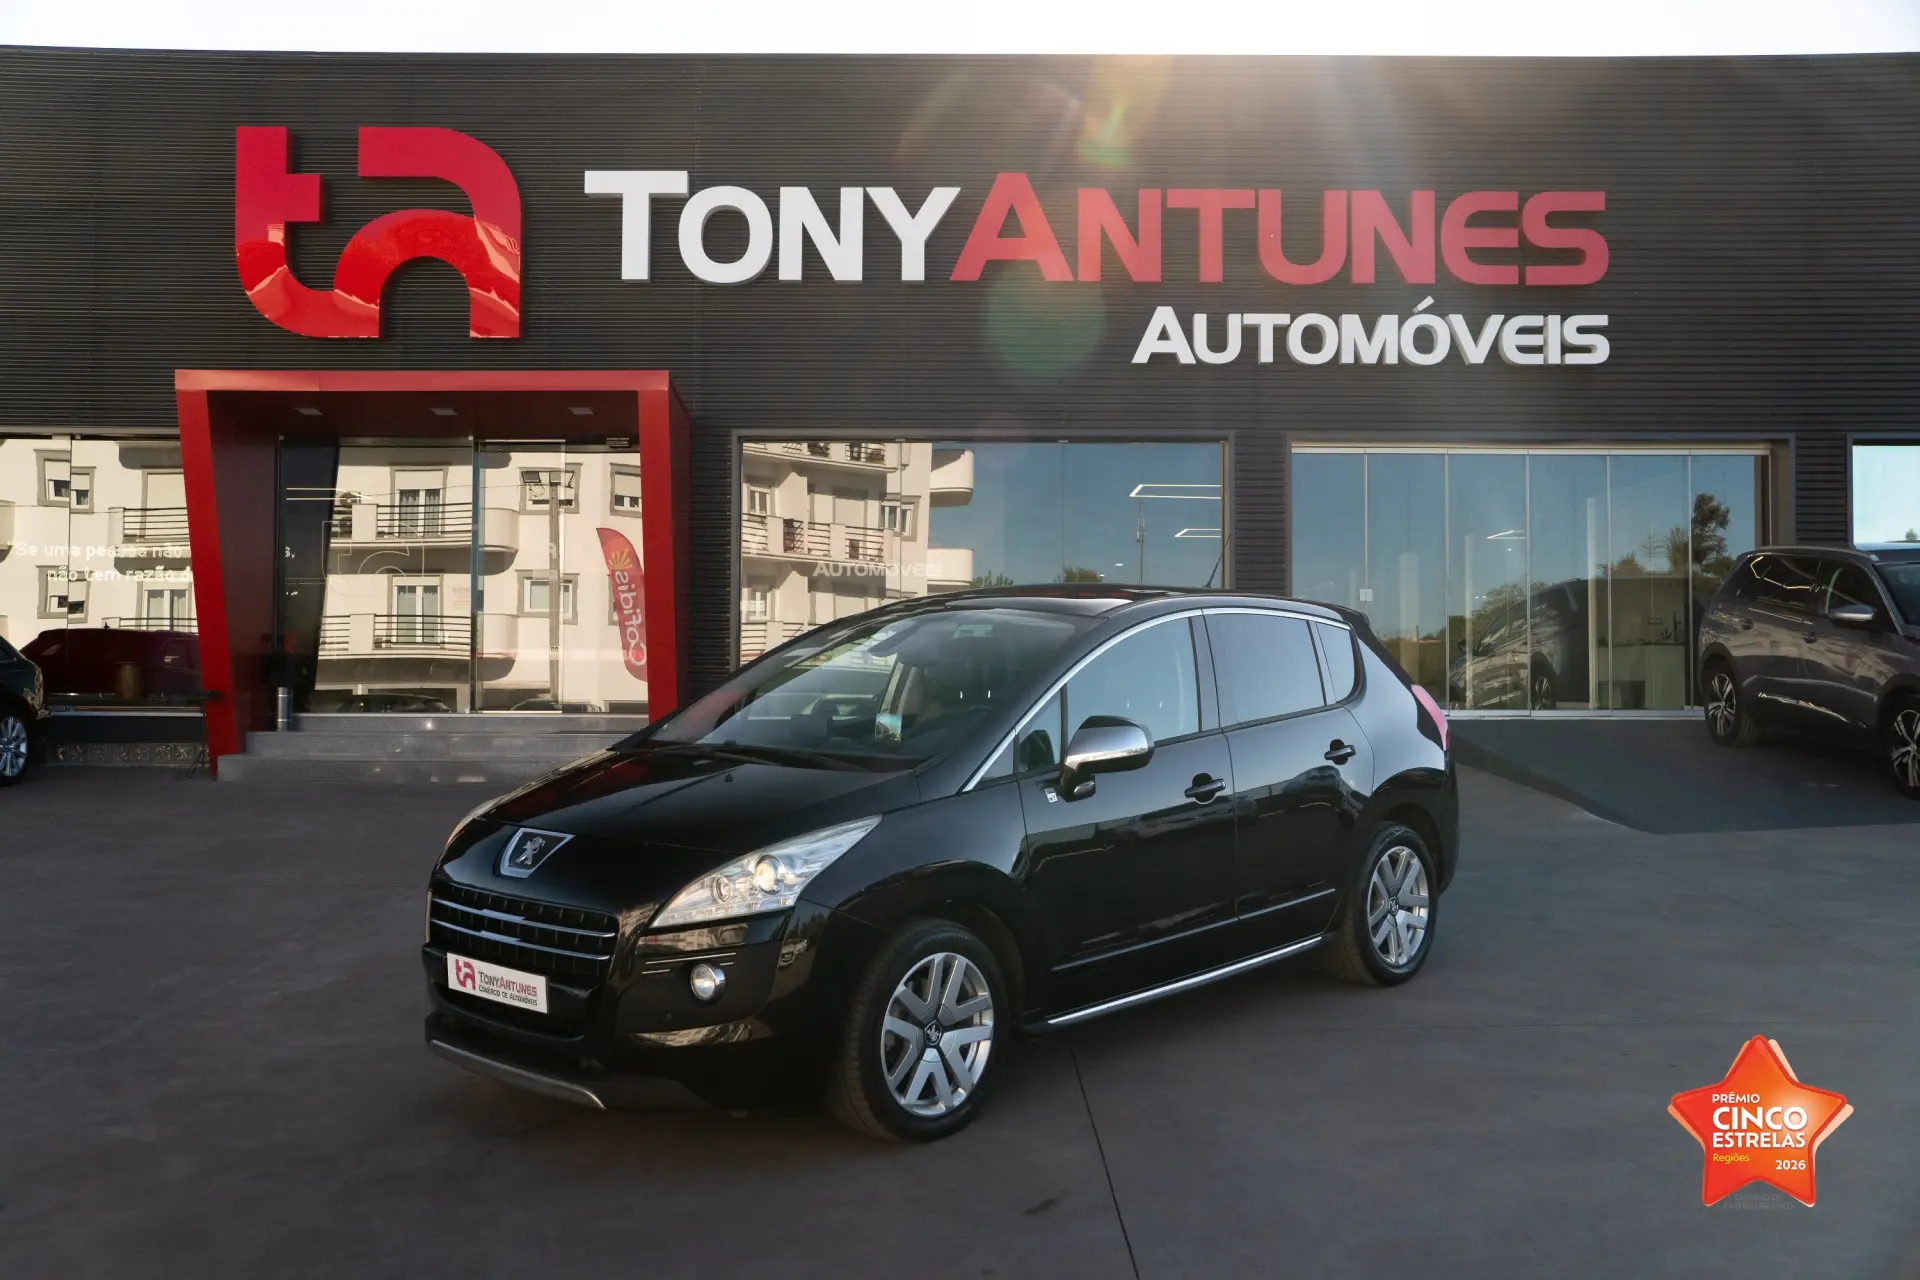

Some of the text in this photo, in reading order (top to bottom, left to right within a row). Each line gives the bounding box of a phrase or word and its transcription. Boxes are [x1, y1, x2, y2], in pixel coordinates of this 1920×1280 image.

[1131, 296, 1610, 365] AUTOMÓVEIS
[44, 545, 81, 557] uma
[152, 542, 183, 558] não
[48, 565, 78, 582] não
[84, 567, 121, 582] tem
[126, 565, 174, 582] razão
